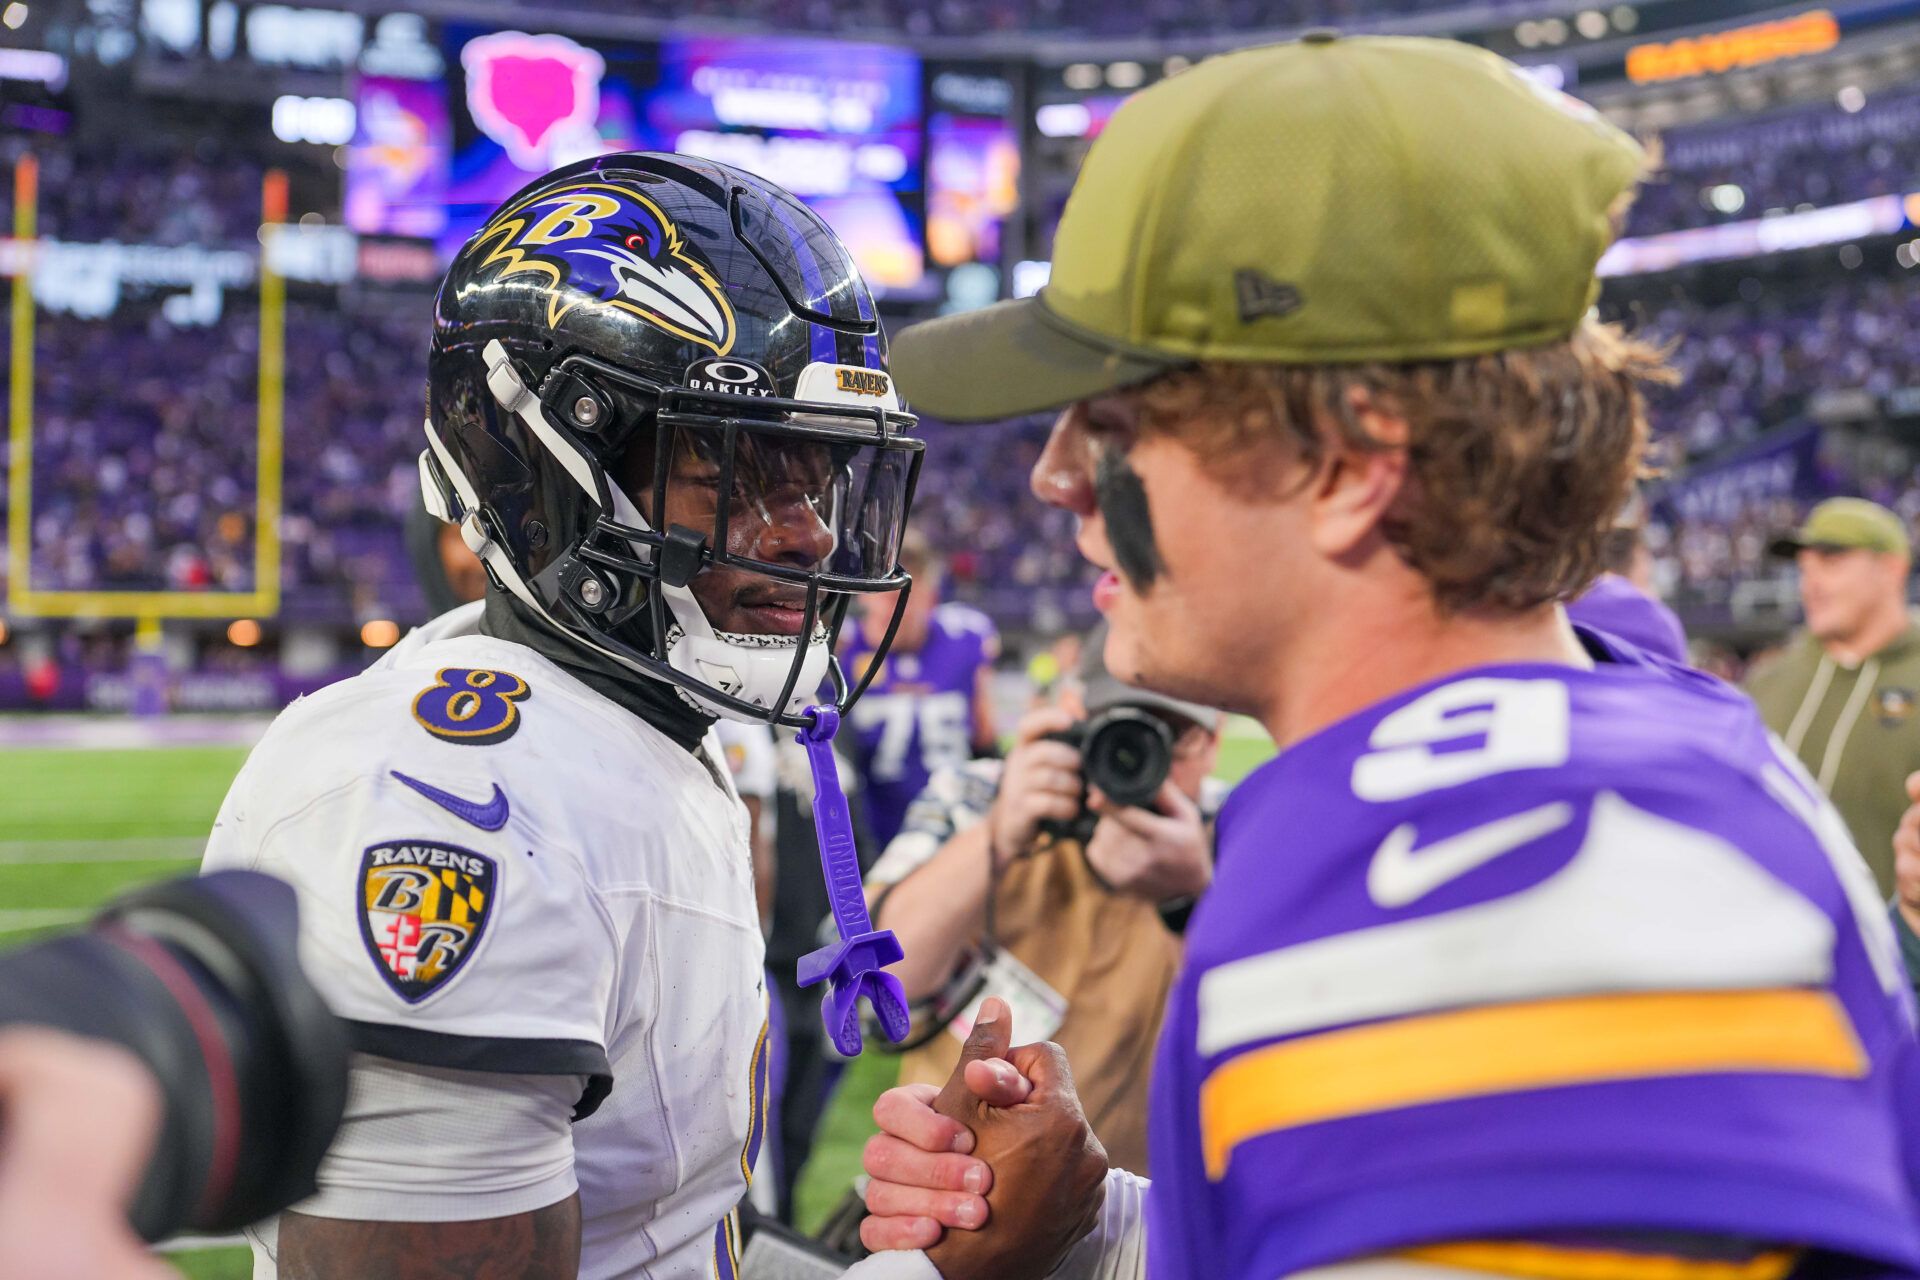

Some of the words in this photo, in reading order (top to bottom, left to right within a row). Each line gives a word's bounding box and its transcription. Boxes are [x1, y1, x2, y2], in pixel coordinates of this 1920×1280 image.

[517, 193, 621, 245] B
[690, 379, 771, 398] OAKLEY
[837, 368, 889, 396] RAVENS
[411, 667, 532, 746] 8
[1350, 677, 1570, 803] 9
[371, 846, 484, 876] RAVENS
[369, 867, 433, 911] B
